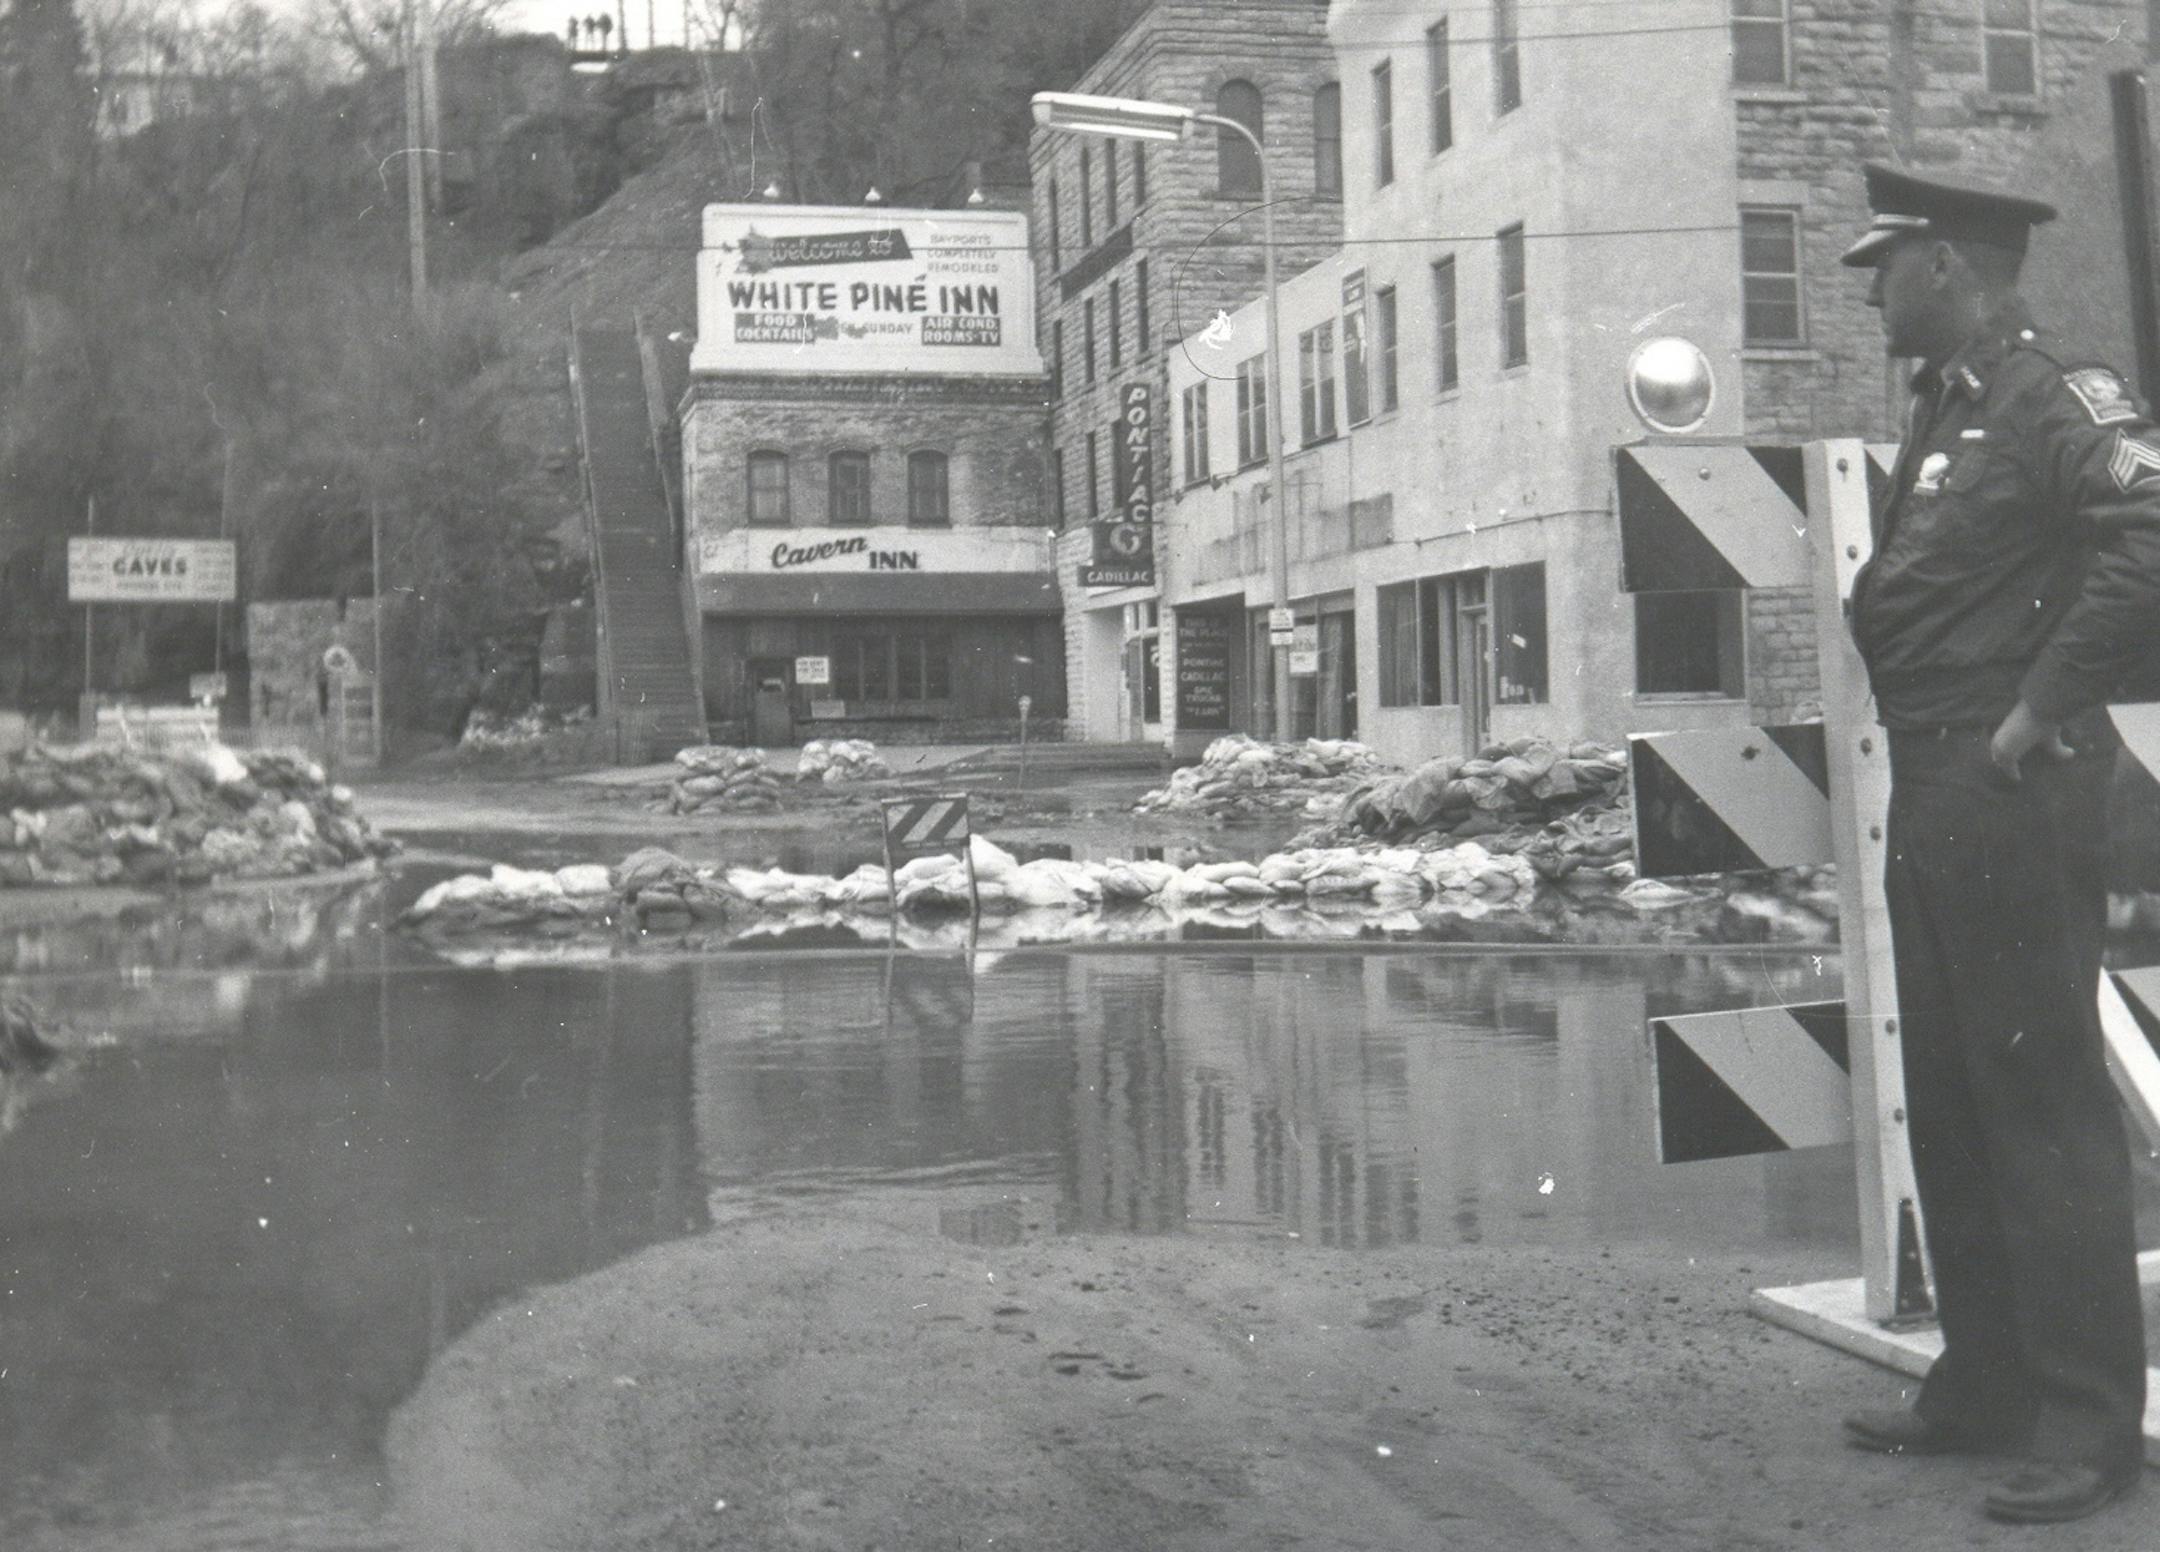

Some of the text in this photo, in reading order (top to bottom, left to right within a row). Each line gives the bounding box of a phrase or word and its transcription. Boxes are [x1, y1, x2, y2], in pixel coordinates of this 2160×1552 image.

[727, 281, 999, 315] WHITE PINE INN
[753, 312, 797, 327] FOOD
[926, 316, 955, 329] AIR
[1125, 387, 1150, 522] PONTIAC
[771, 535, 918, 570] Cavern INN
[112, 555, 188, 577] CAVES
[1086, 570, 1150, 584] CADILLAC
